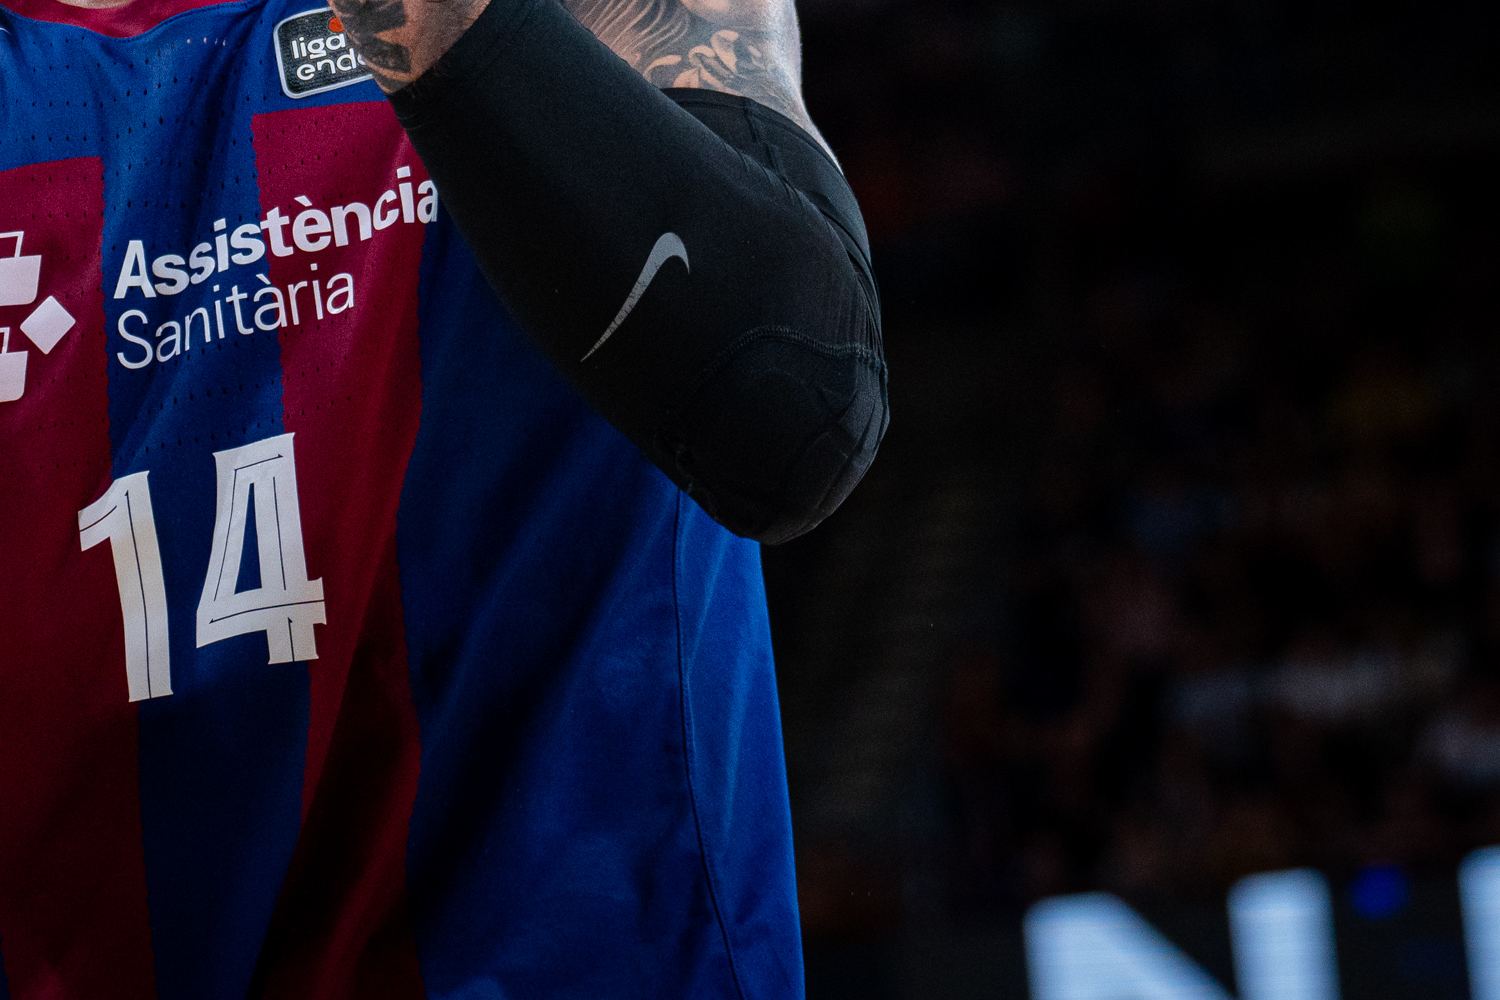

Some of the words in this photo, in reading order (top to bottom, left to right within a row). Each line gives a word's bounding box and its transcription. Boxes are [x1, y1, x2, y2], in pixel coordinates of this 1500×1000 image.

[291, 33, 346, 60] liga
[113, 165, 439, 299] Assistència
[116, 263, 355, 370] Sanitària
[77, 432, 327, 702] 14
